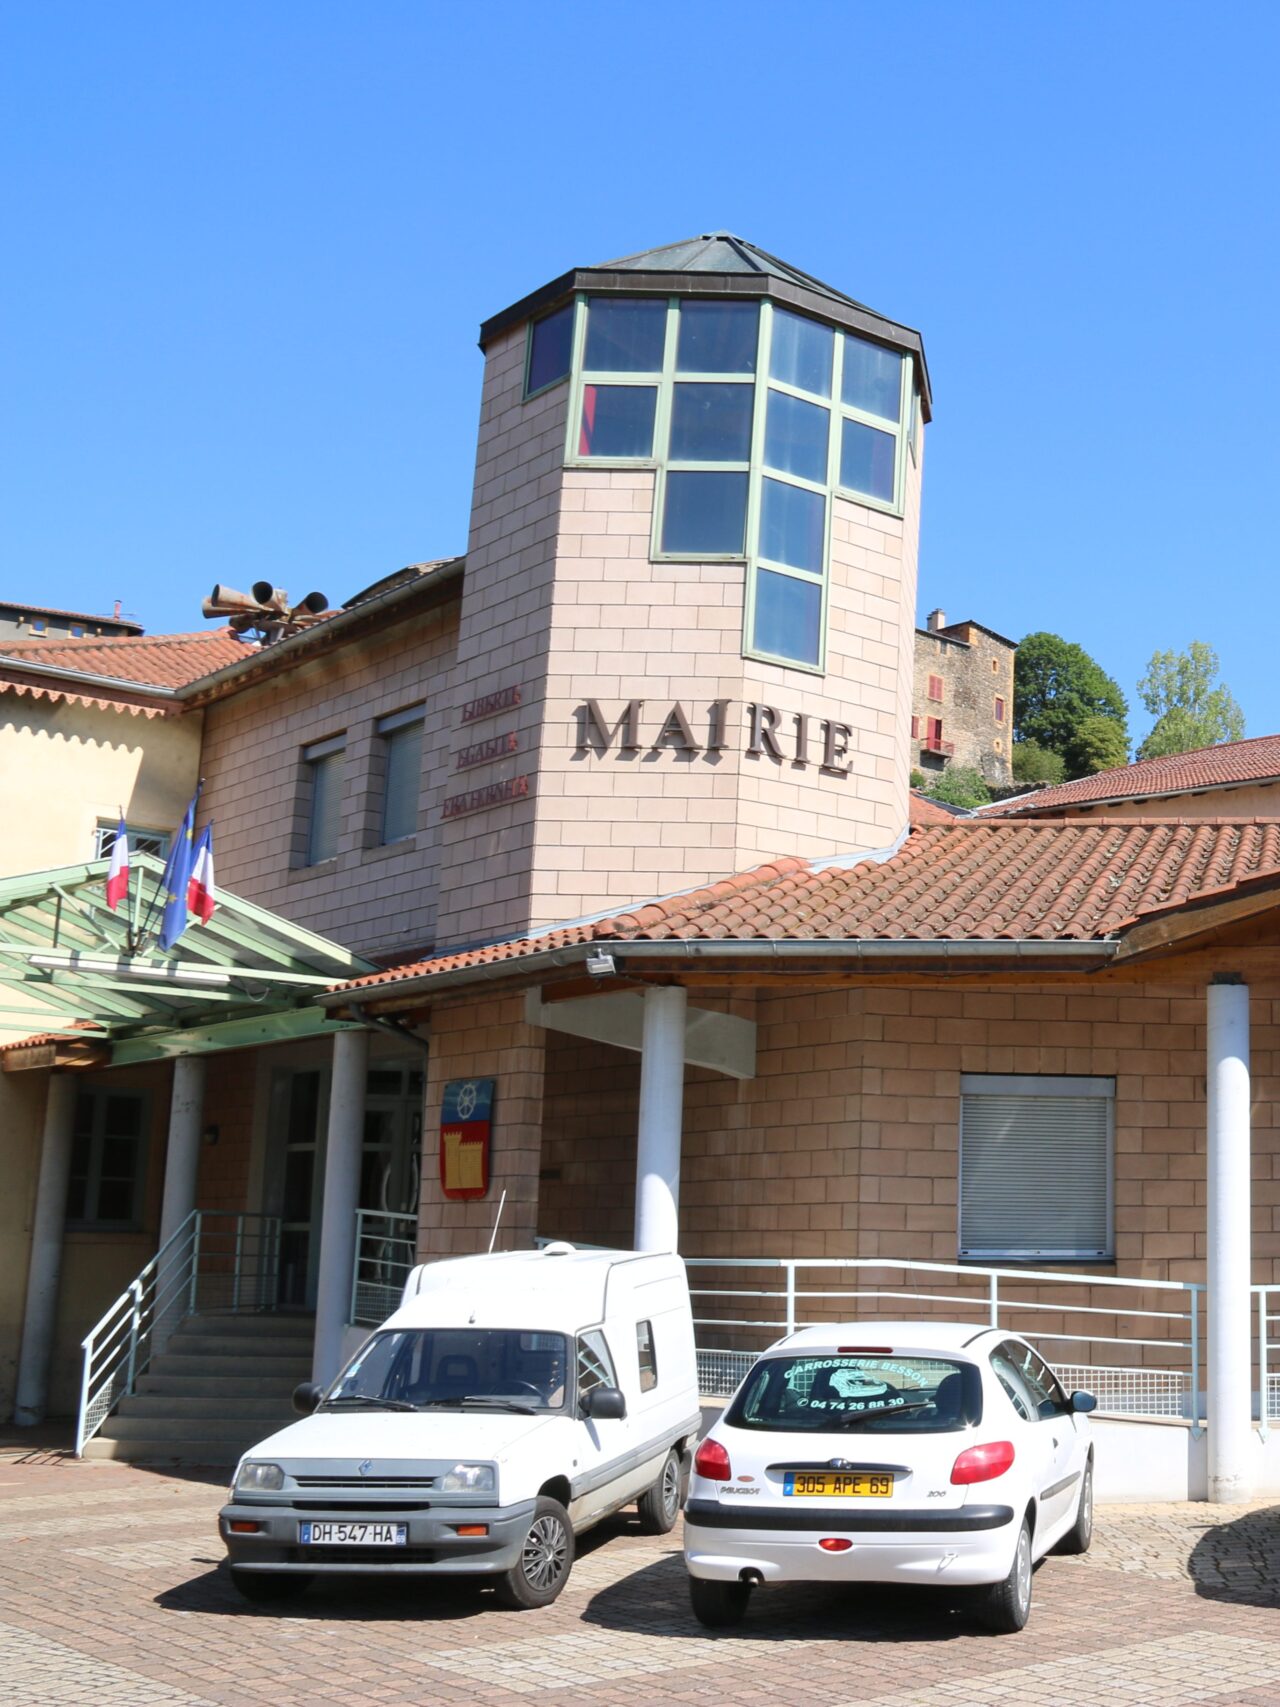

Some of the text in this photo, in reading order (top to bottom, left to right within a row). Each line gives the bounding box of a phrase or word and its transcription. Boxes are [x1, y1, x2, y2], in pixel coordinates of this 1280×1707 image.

[576, 698, 853, 773] MAIRIE
[784, 1359, 929, 1387] CARROSSERIE BESSON
[810, 1401, 827, 1409] 04
[829, 1402, 846, 1410] 74
[849, 1402, 865, 1410] 26
[888, 1398, 905, 1406] 30
[796, 1476, 890, 1494] 305 APE 69
[312, 1525, 393, 1543] DH-547-HA
